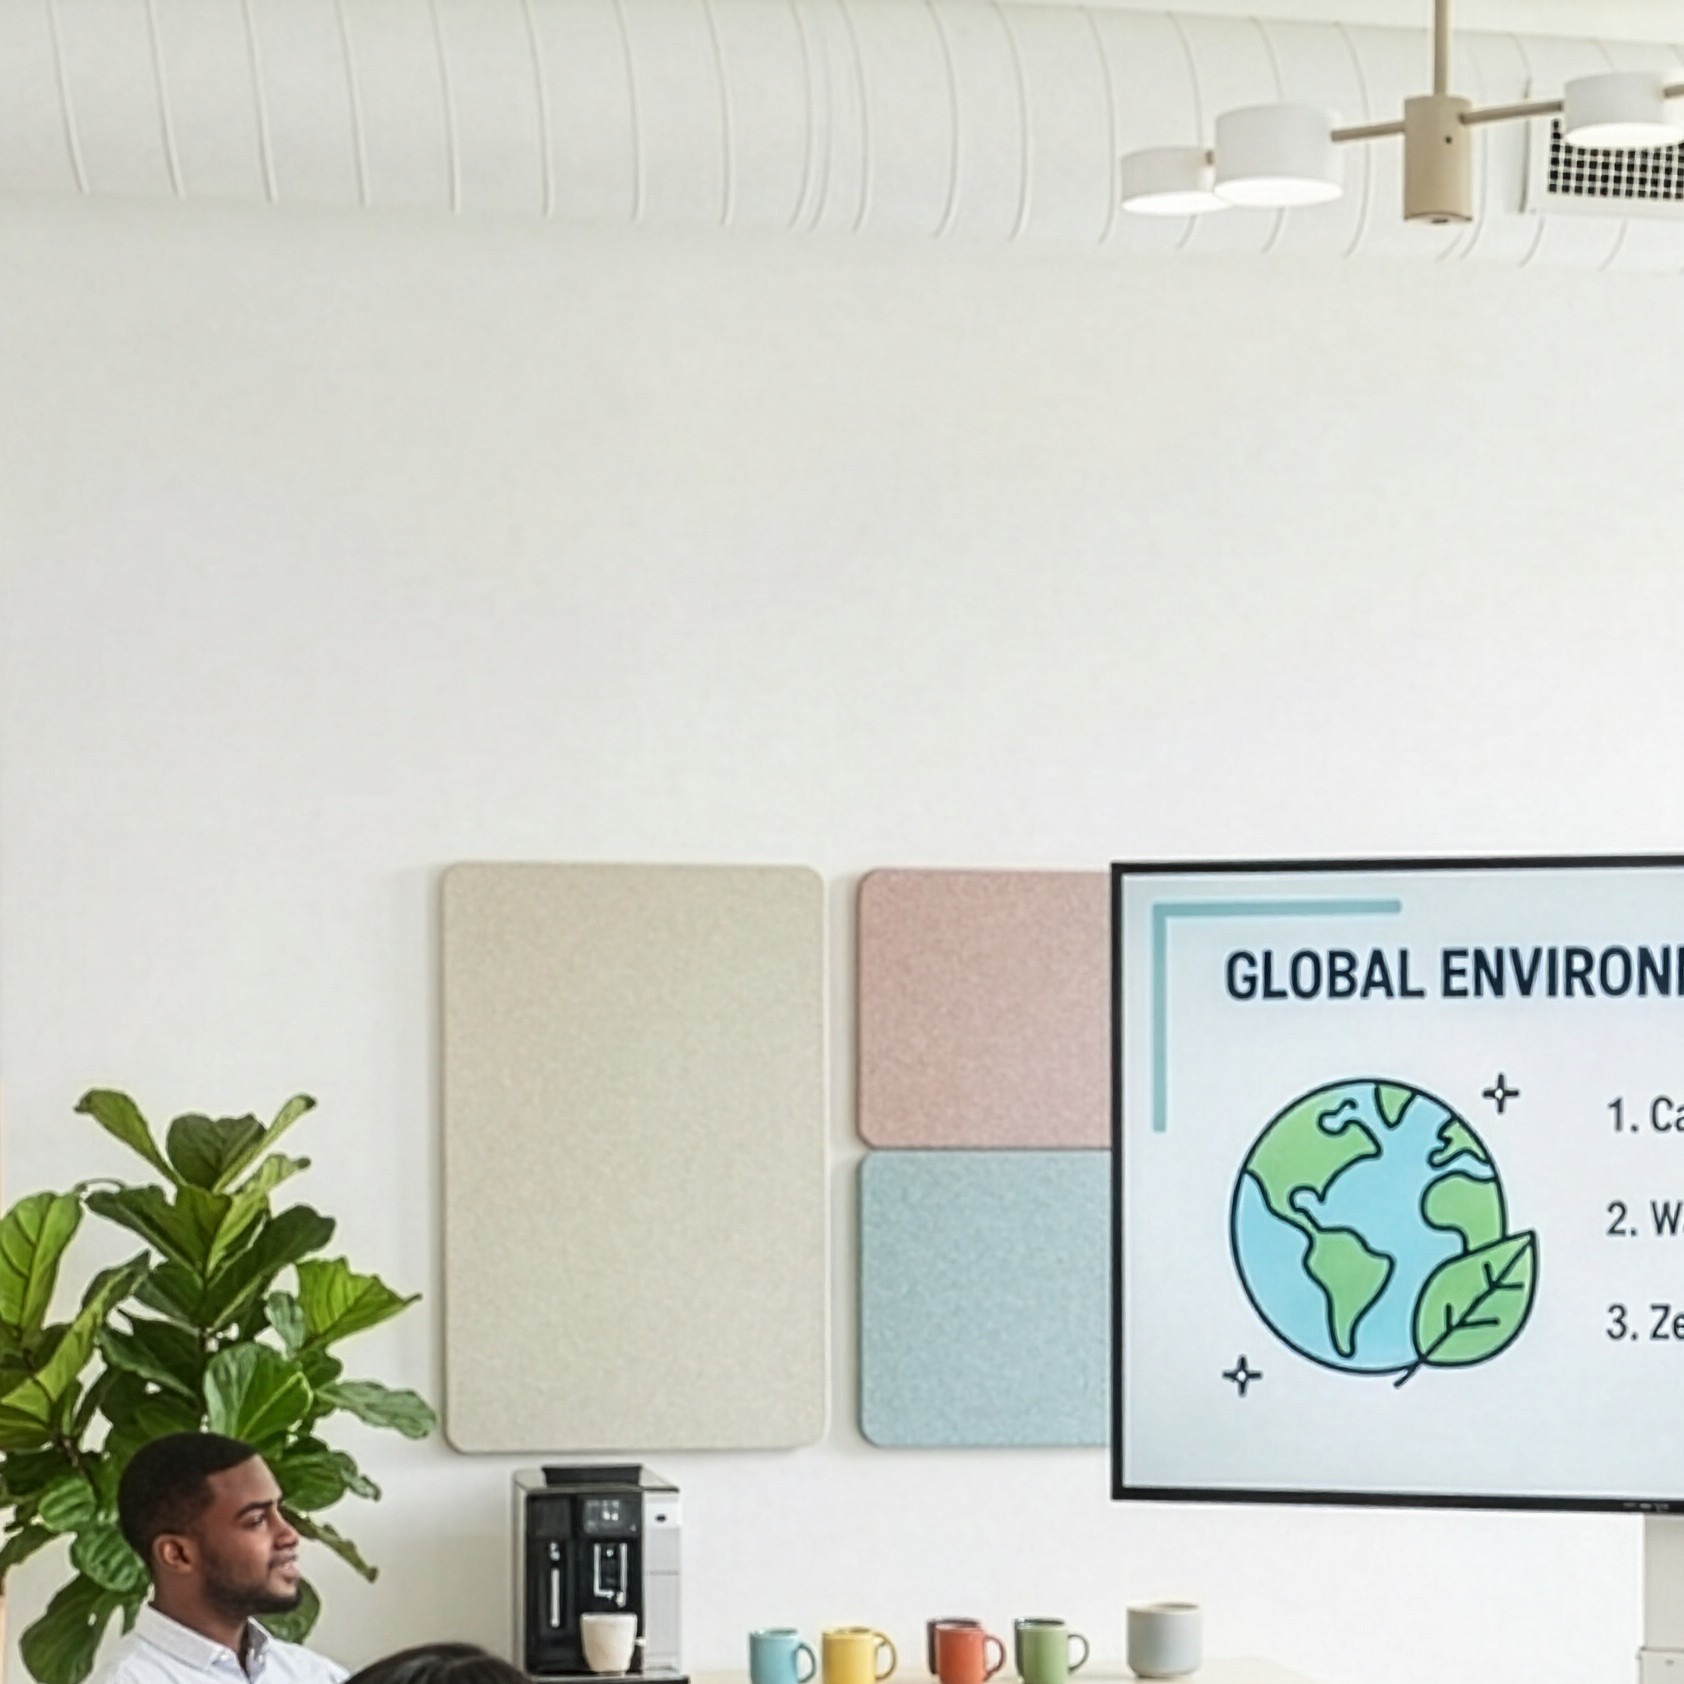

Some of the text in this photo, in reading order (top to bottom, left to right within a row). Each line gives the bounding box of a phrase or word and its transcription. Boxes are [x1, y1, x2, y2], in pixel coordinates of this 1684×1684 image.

[1226, 948, 1426, 1001] GLOBAL
[1608, 1097, 1639, 1133] 1.
[1607, 1200, 1637, 1237] 2.
[1606, 1303, 1638, 1341] 3.
